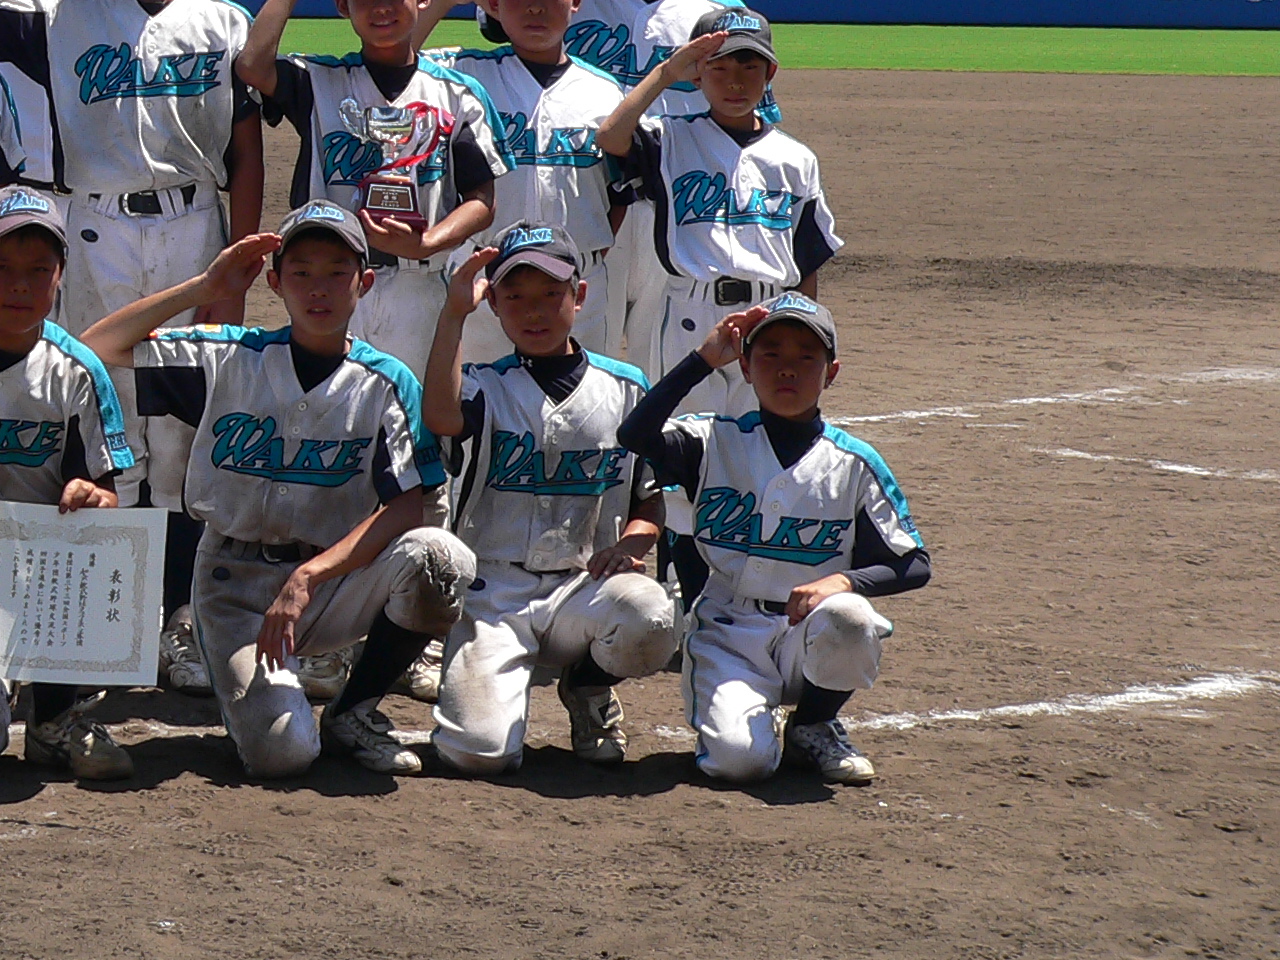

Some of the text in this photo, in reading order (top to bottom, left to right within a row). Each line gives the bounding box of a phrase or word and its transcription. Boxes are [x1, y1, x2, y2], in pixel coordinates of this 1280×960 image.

[75, 43, 226, 104] WAKE
[211, 412, 372, 488] WAKE
[487, 430, 628, 496] WAKE
[695, 487, 854, 567] WAKE
[106, 569, 122, 622] 表彰状
